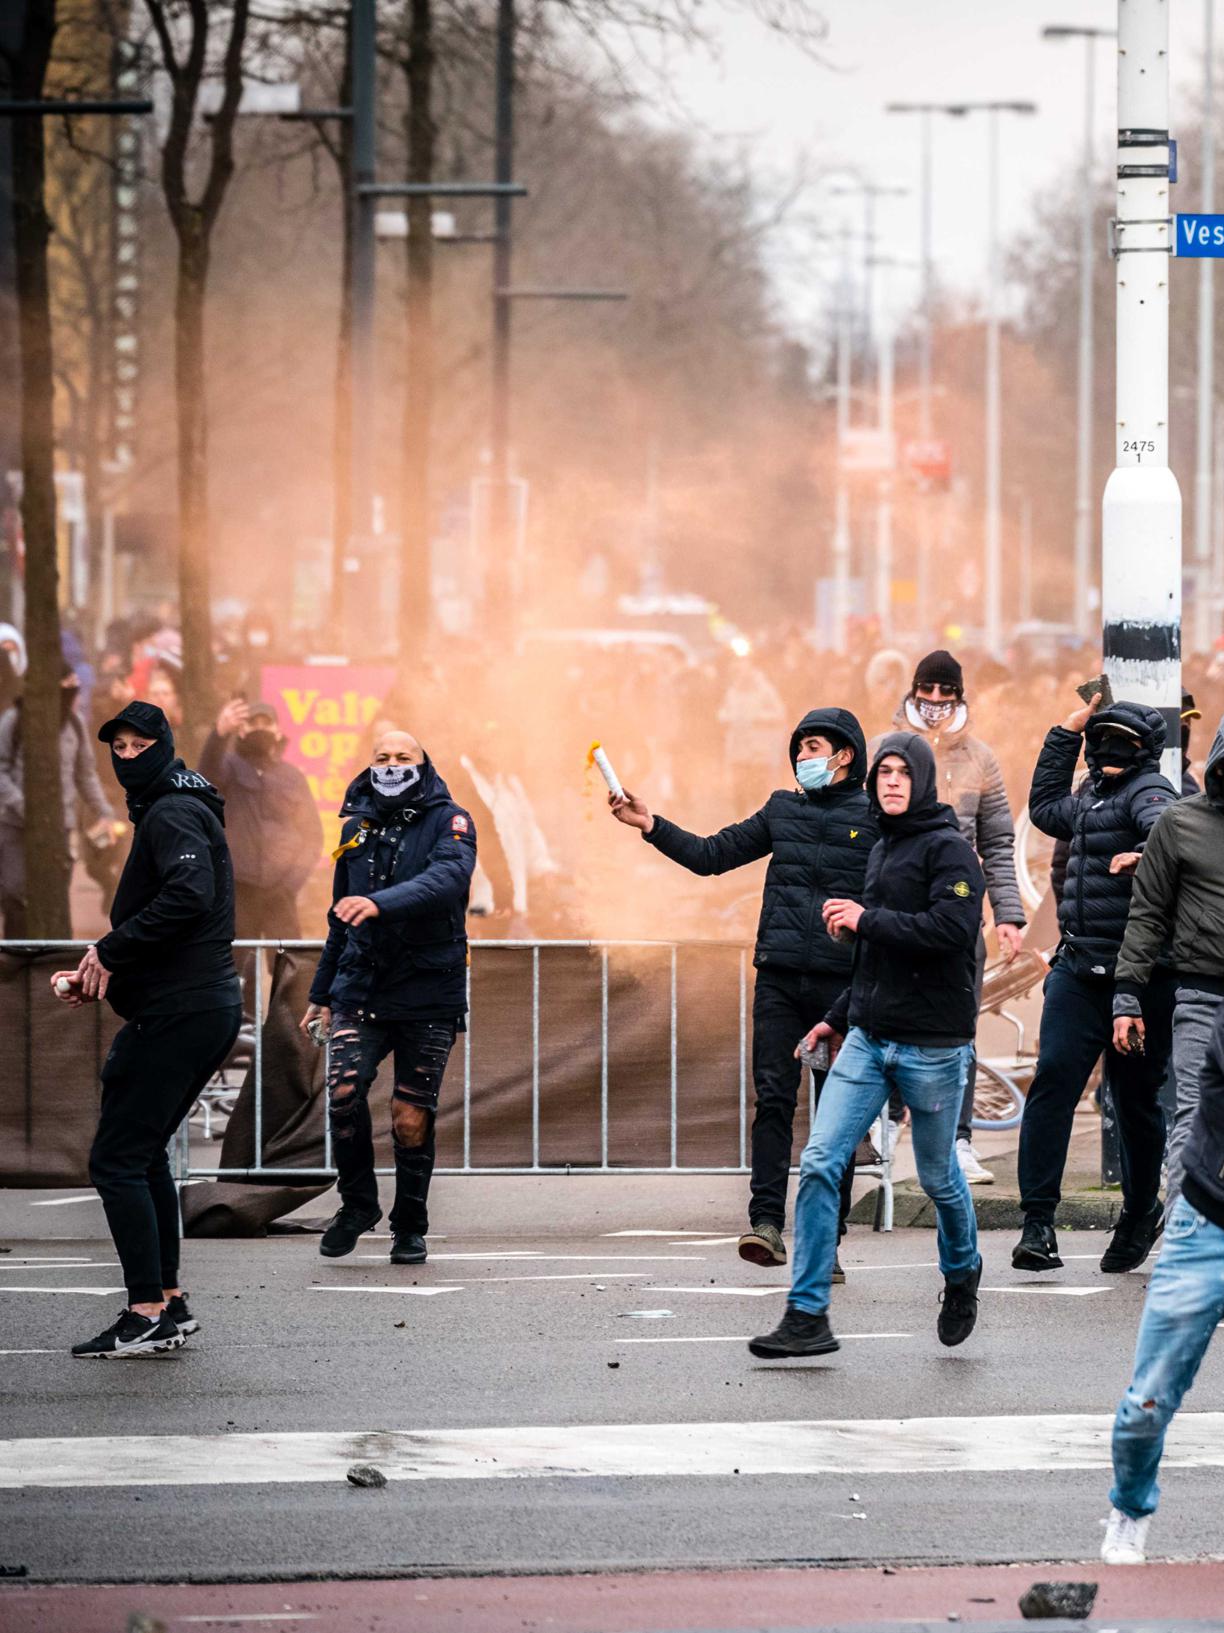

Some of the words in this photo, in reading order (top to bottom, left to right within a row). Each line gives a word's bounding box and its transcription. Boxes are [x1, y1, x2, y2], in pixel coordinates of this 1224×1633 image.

[1122, 440, 1156, 452] 2475
[1135, 452, 1142, 464] 1
[299, 730, 361, 766] op
